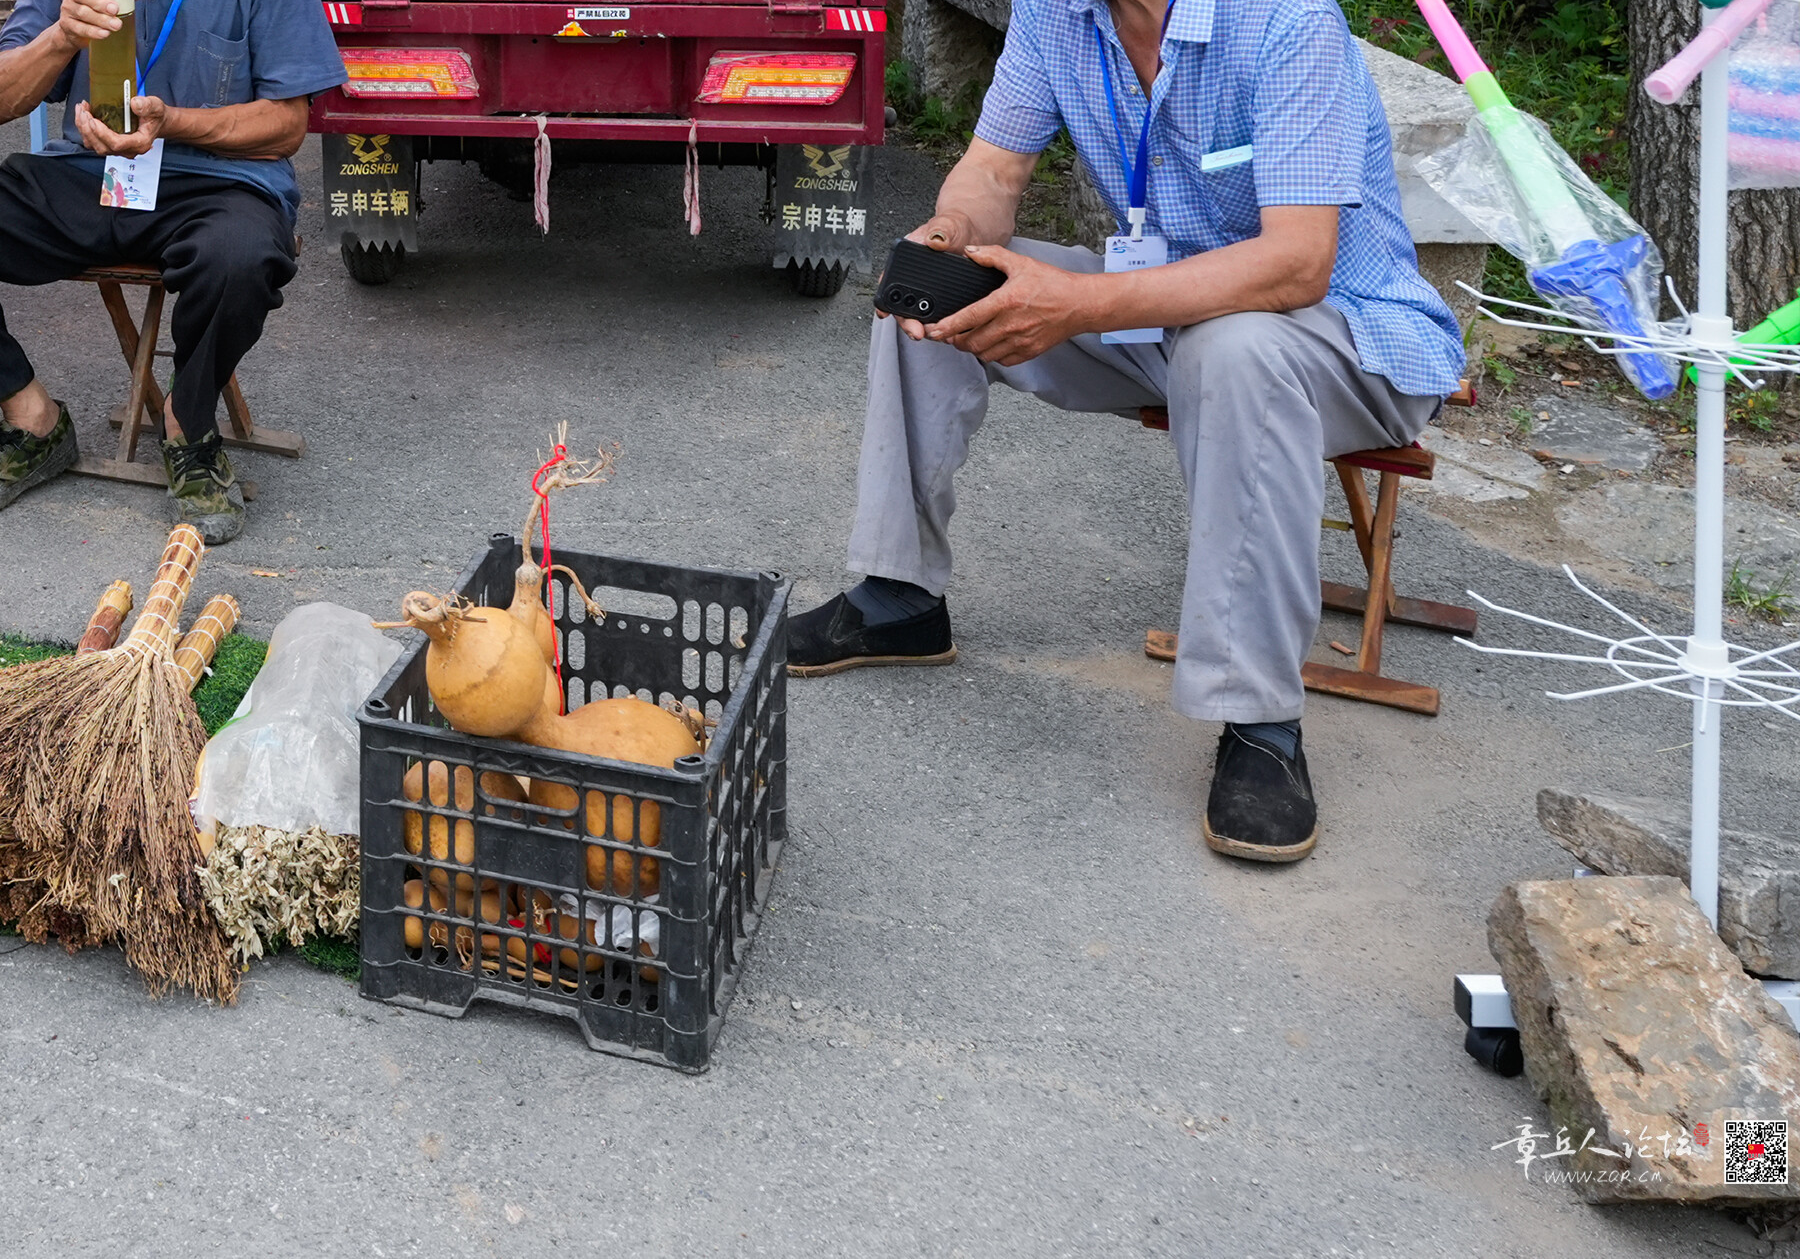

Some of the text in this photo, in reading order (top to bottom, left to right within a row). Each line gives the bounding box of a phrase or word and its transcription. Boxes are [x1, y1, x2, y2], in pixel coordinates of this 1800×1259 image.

[577, 10, 627, 18] 严禁私自改装
[339, 163, 399, 176] ZONGSHEN
[794, 177, 858, 192] ZONGSHEN
[330, 188, 410, 217] 宗申车辆
[782, 202, 867, 236] 宗申车辆
